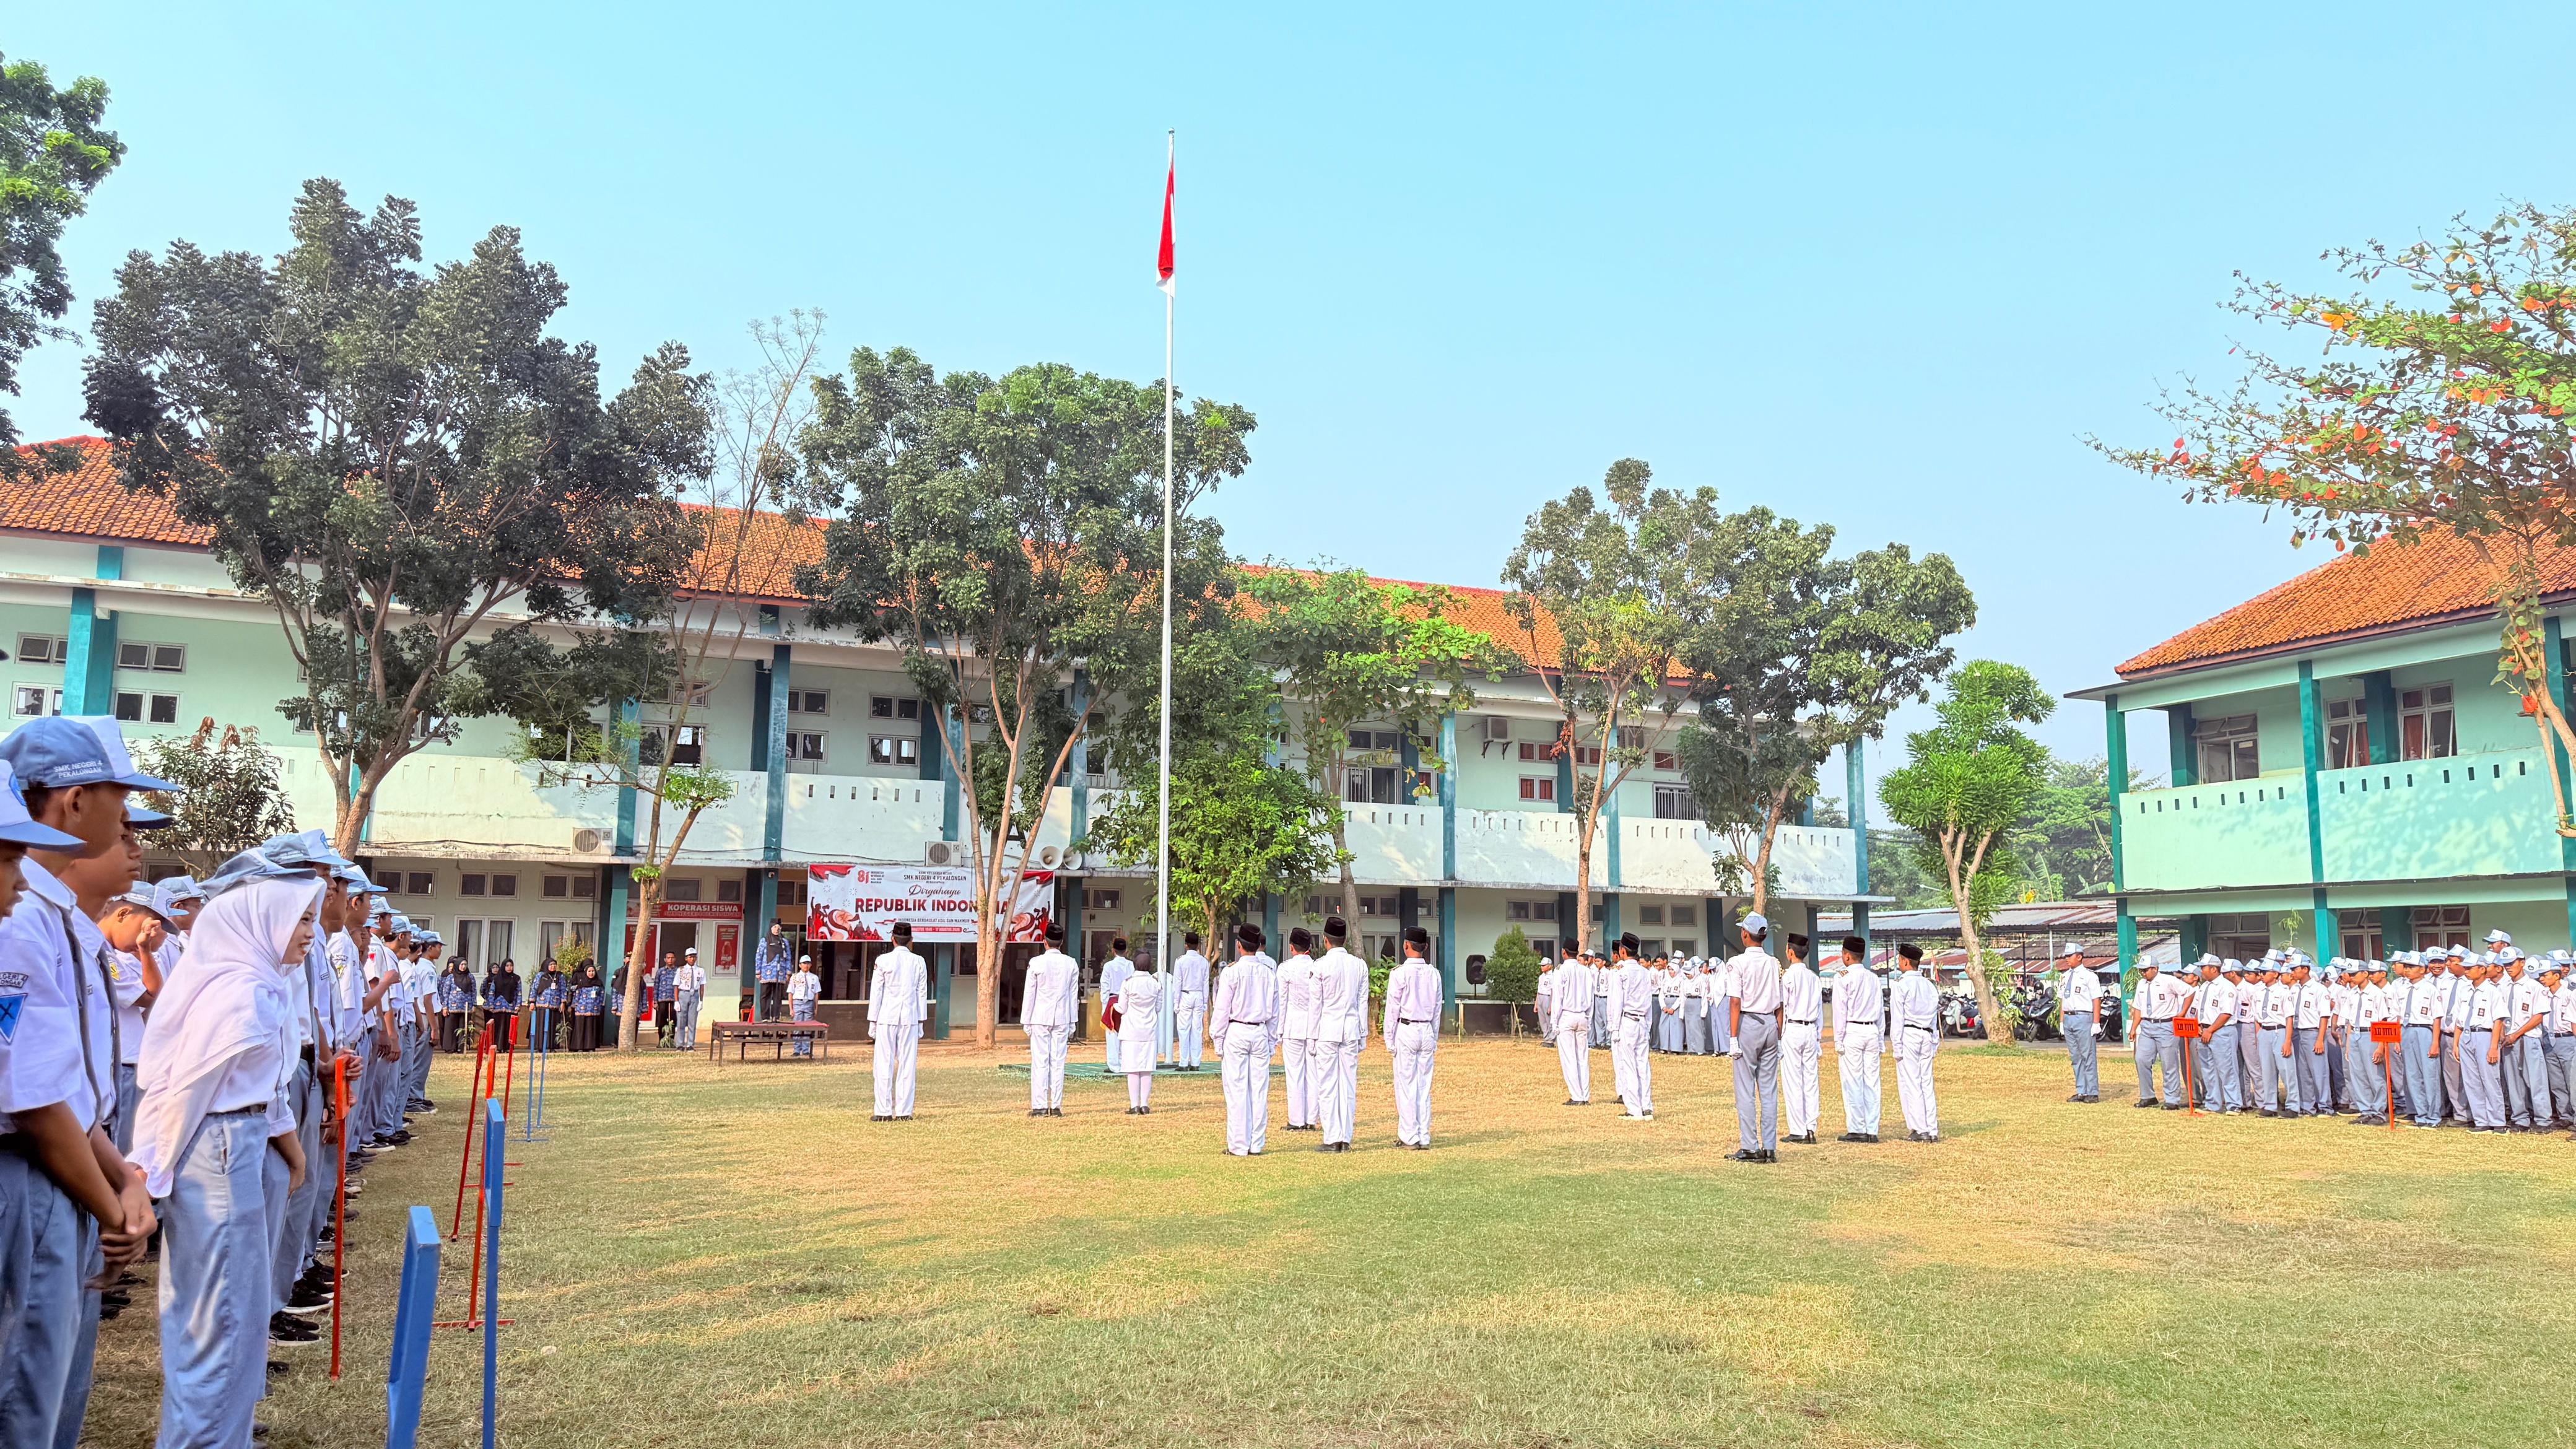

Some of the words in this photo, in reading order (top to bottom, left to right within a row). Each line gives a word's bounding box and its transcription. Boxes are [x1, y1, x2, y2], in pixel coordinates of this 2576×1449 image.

[72, 761, 97, 769] NEGERI
[58, 767, 102, 778] PEKALONGAN
[908, 884, 961, 898] Dirgahayu
[855, 899, 927, 913] REPUBLIK
[932, 900, 1009, 914] INDONIA
